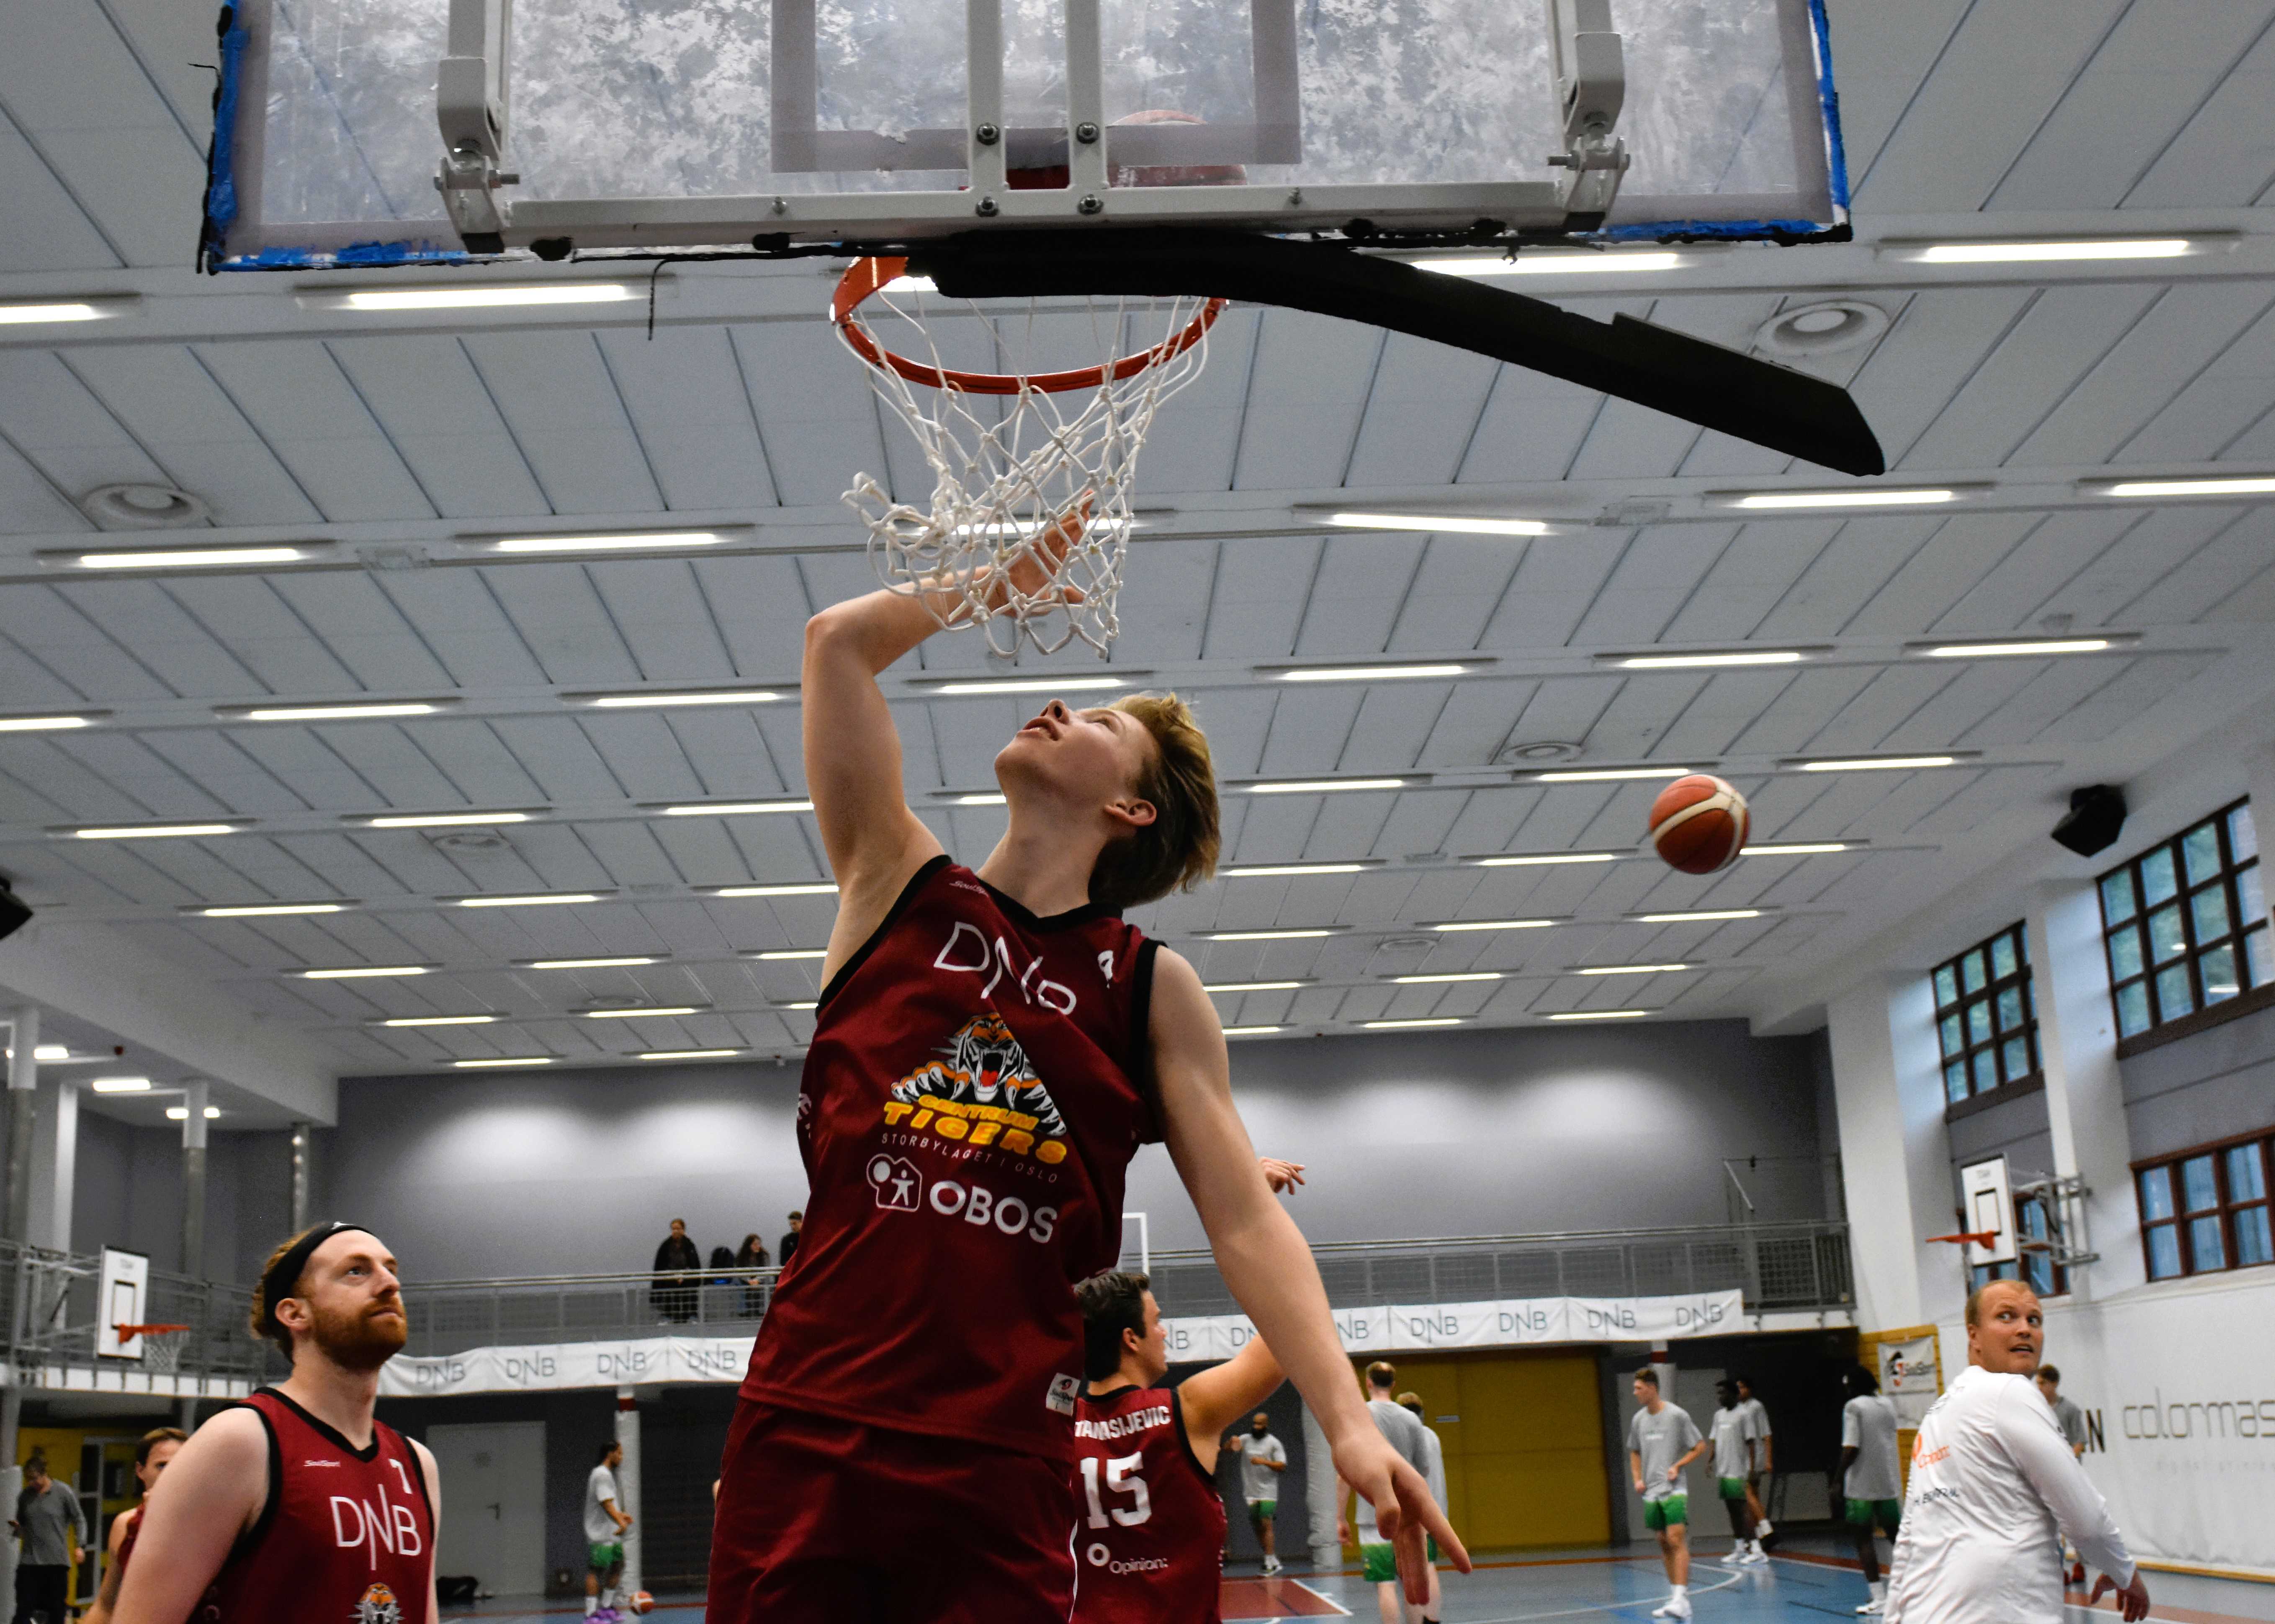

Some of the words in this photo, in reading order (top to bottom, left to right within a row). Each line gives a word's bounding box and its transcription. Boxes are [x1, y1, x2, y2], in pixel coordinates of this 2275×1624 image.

[918, 1094, 1040, 1131] CENTRUM
[884, 1101, 1067, 1164] TIGERS
[881, 1133, 993, 1163] STORBYLAGET
[1015, 1162, 1058, 1184] OSLO
[929, 1180, 1058, 1244] OBOS
[1336, 1313, 1369, 1339] NB
[1410, 1309, 1459, 1343] DNB
[1499, 1304, 1547, 1338] DNB
[1587, 1303, 1636, 1335] DNB
[1676, 1298, 1723, 1332] DNB
[1164, 1323, 1190, 1349] NB
[416, 1359, 466, 1390] DNB
[505, 1351, 556, 1385] DNB
[597, 1345, 646, 1380] DNB
[688, 1343, 736, 1376] DNB
[1080, 1451, 1152, 1529] 15
[329, 1484, 422, 1571] DNB
